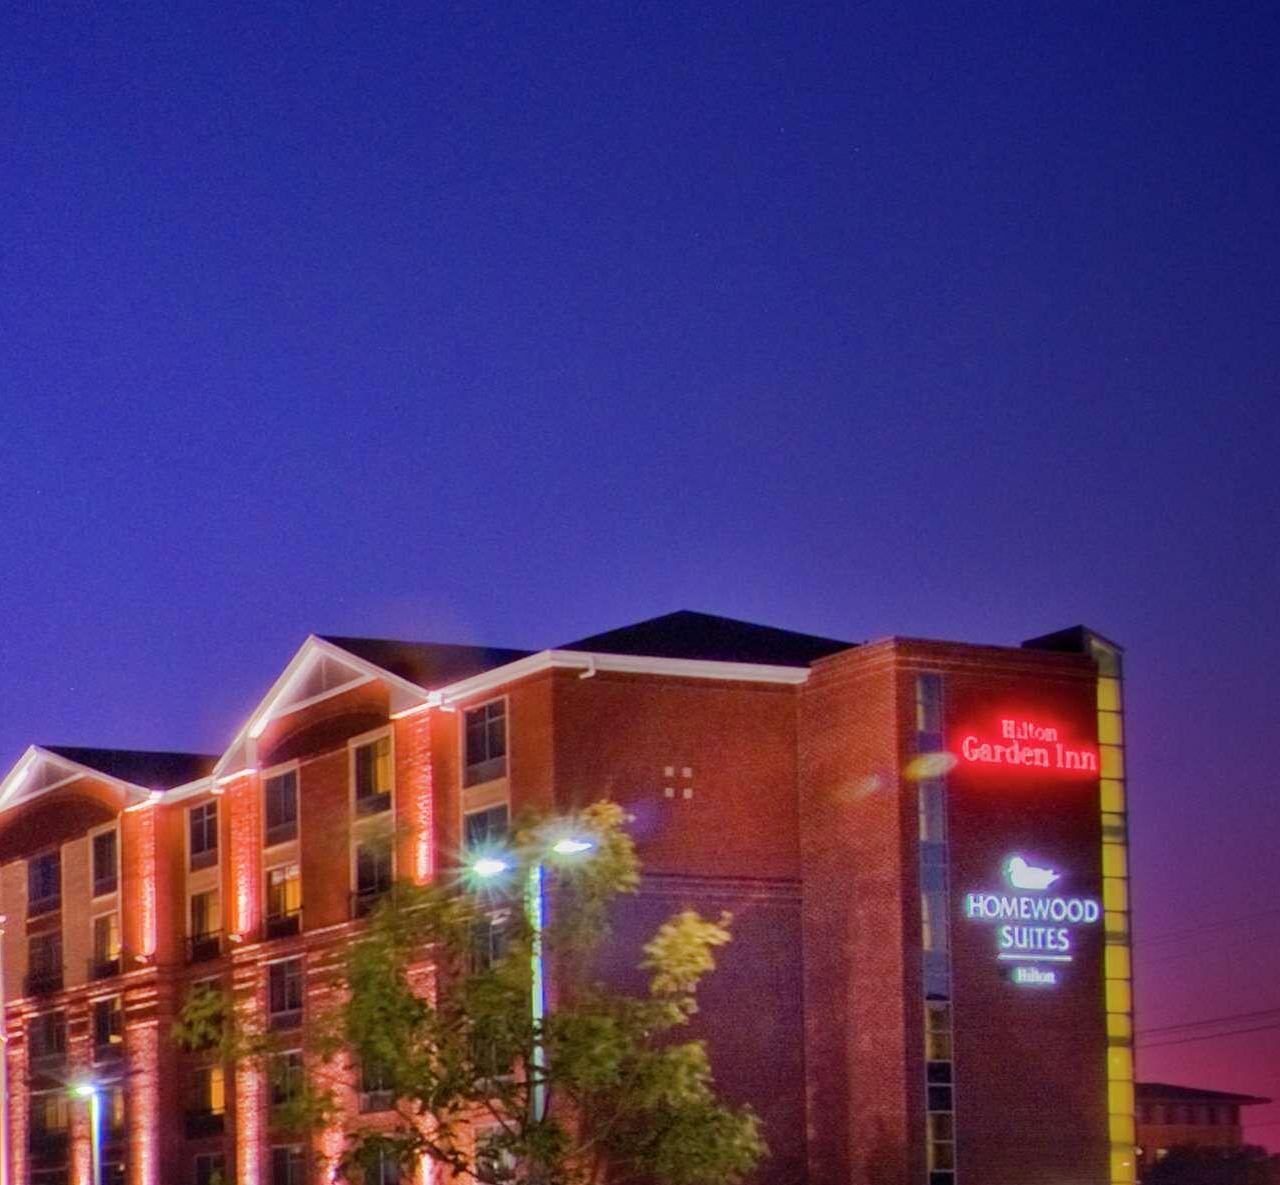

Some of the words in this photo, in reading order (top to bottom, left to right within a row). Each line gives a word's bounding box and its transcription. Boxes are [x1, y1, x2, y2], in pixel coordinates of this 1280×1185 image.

[1001, 719, 1058, 742] Hilton
[962, 735, 1049, 768] Garden
[1056, 743, 1097, 770] Inn
[967, 895, 1099, 922] HOMEWOOD
[1000, 925, 1069, 949] SUITES
[1015, 967, 1056, 984] Hilton
